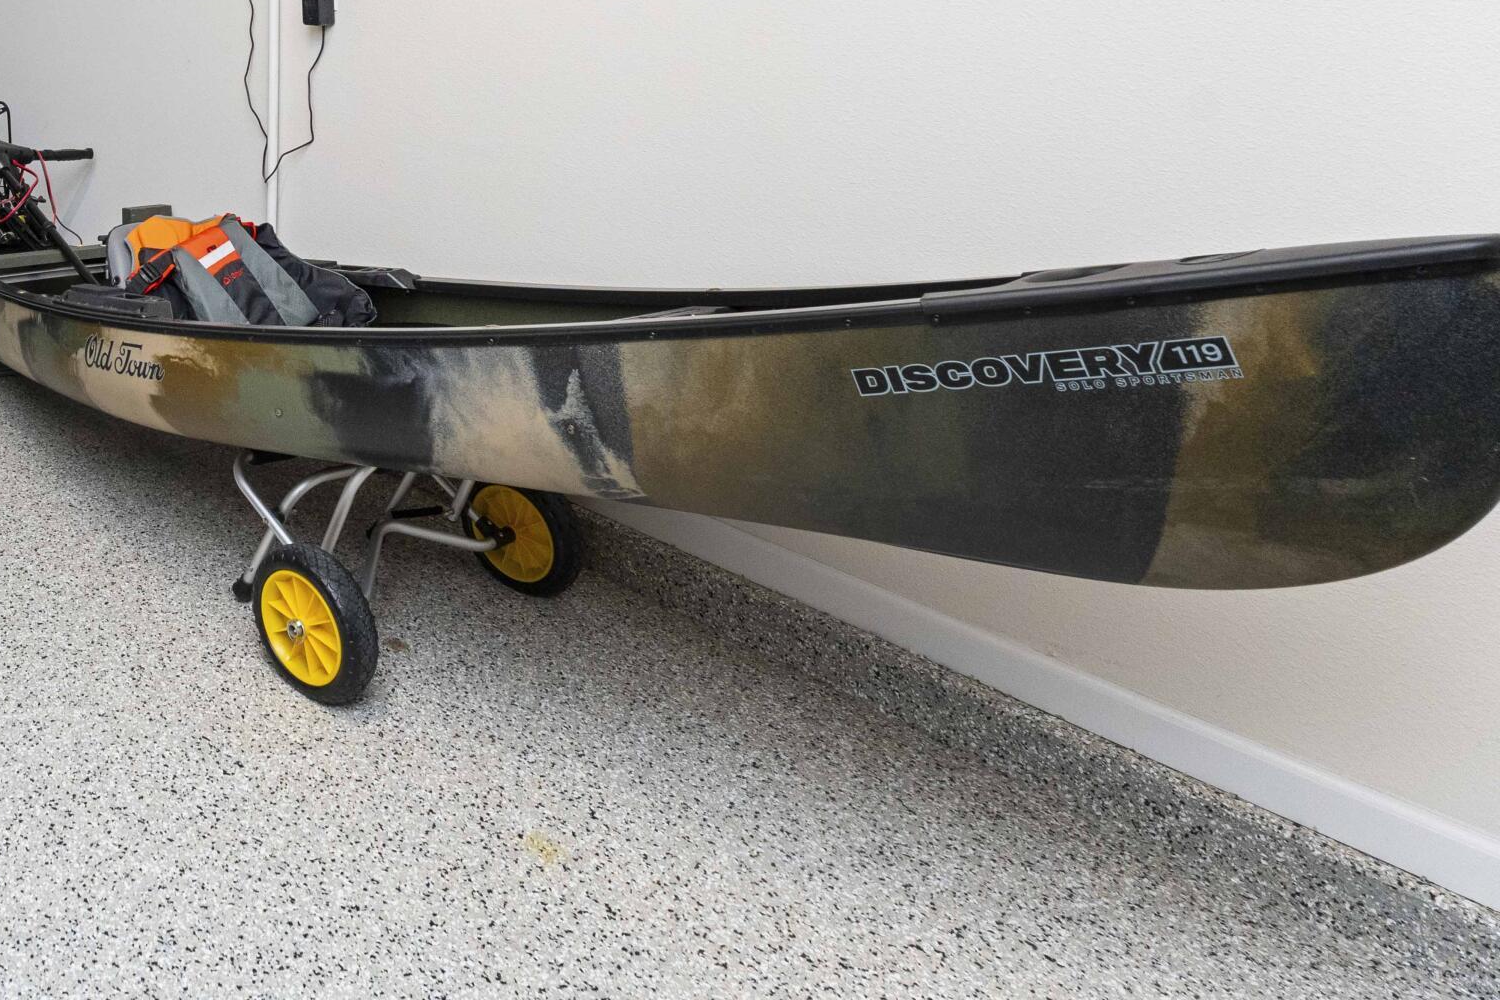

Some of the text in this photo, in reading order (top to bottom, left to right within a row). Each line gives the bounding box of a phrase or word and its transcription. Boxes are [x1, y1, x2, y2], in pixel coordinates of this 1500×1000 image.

[85, 334, 164, 381] Old Town
[851, 341, 1224, 396] DISCOVERY 119
[1055, 368, 1245, 392] SOLO SPORTSMAN
